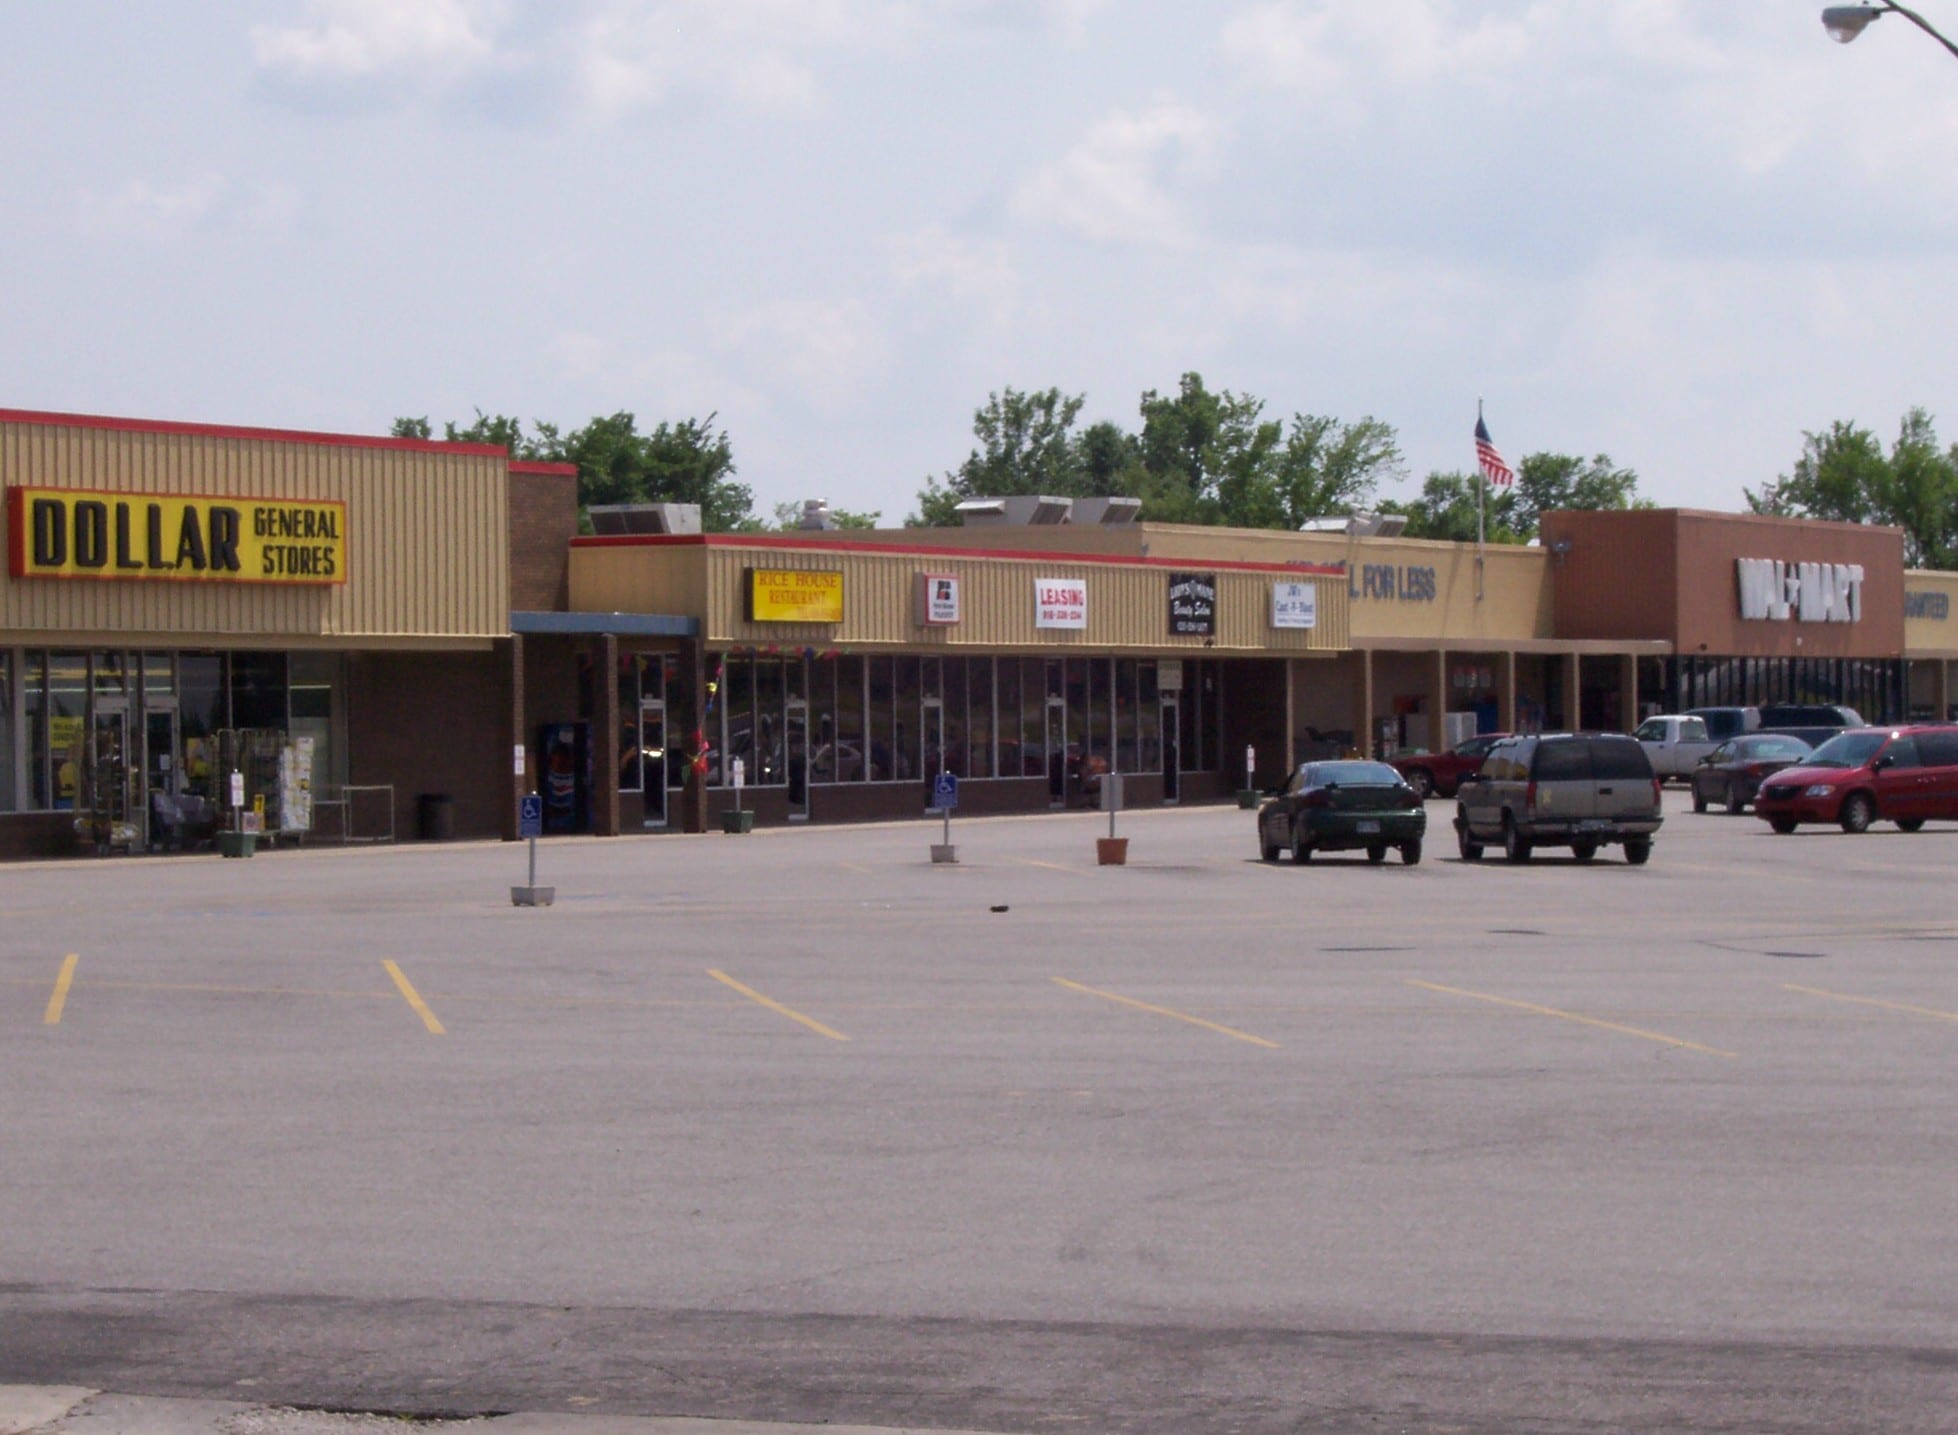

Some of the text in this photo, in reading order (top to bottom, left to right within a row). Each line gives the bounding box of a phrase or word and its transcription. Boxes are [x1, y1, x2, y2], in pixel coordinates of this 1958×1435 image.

[33, 498, 242, 572] DOLLAR
[253, 506, 340, 540] GENERAL
[262, 544, 336, 576] STORES
[759, 571, 838, 589] RICE HOUSE
[1363, 563, 1395, 599] FOR
[1398, 565, 1437, 602] LESS
[1040, 587, 1084, 607] LEASING
